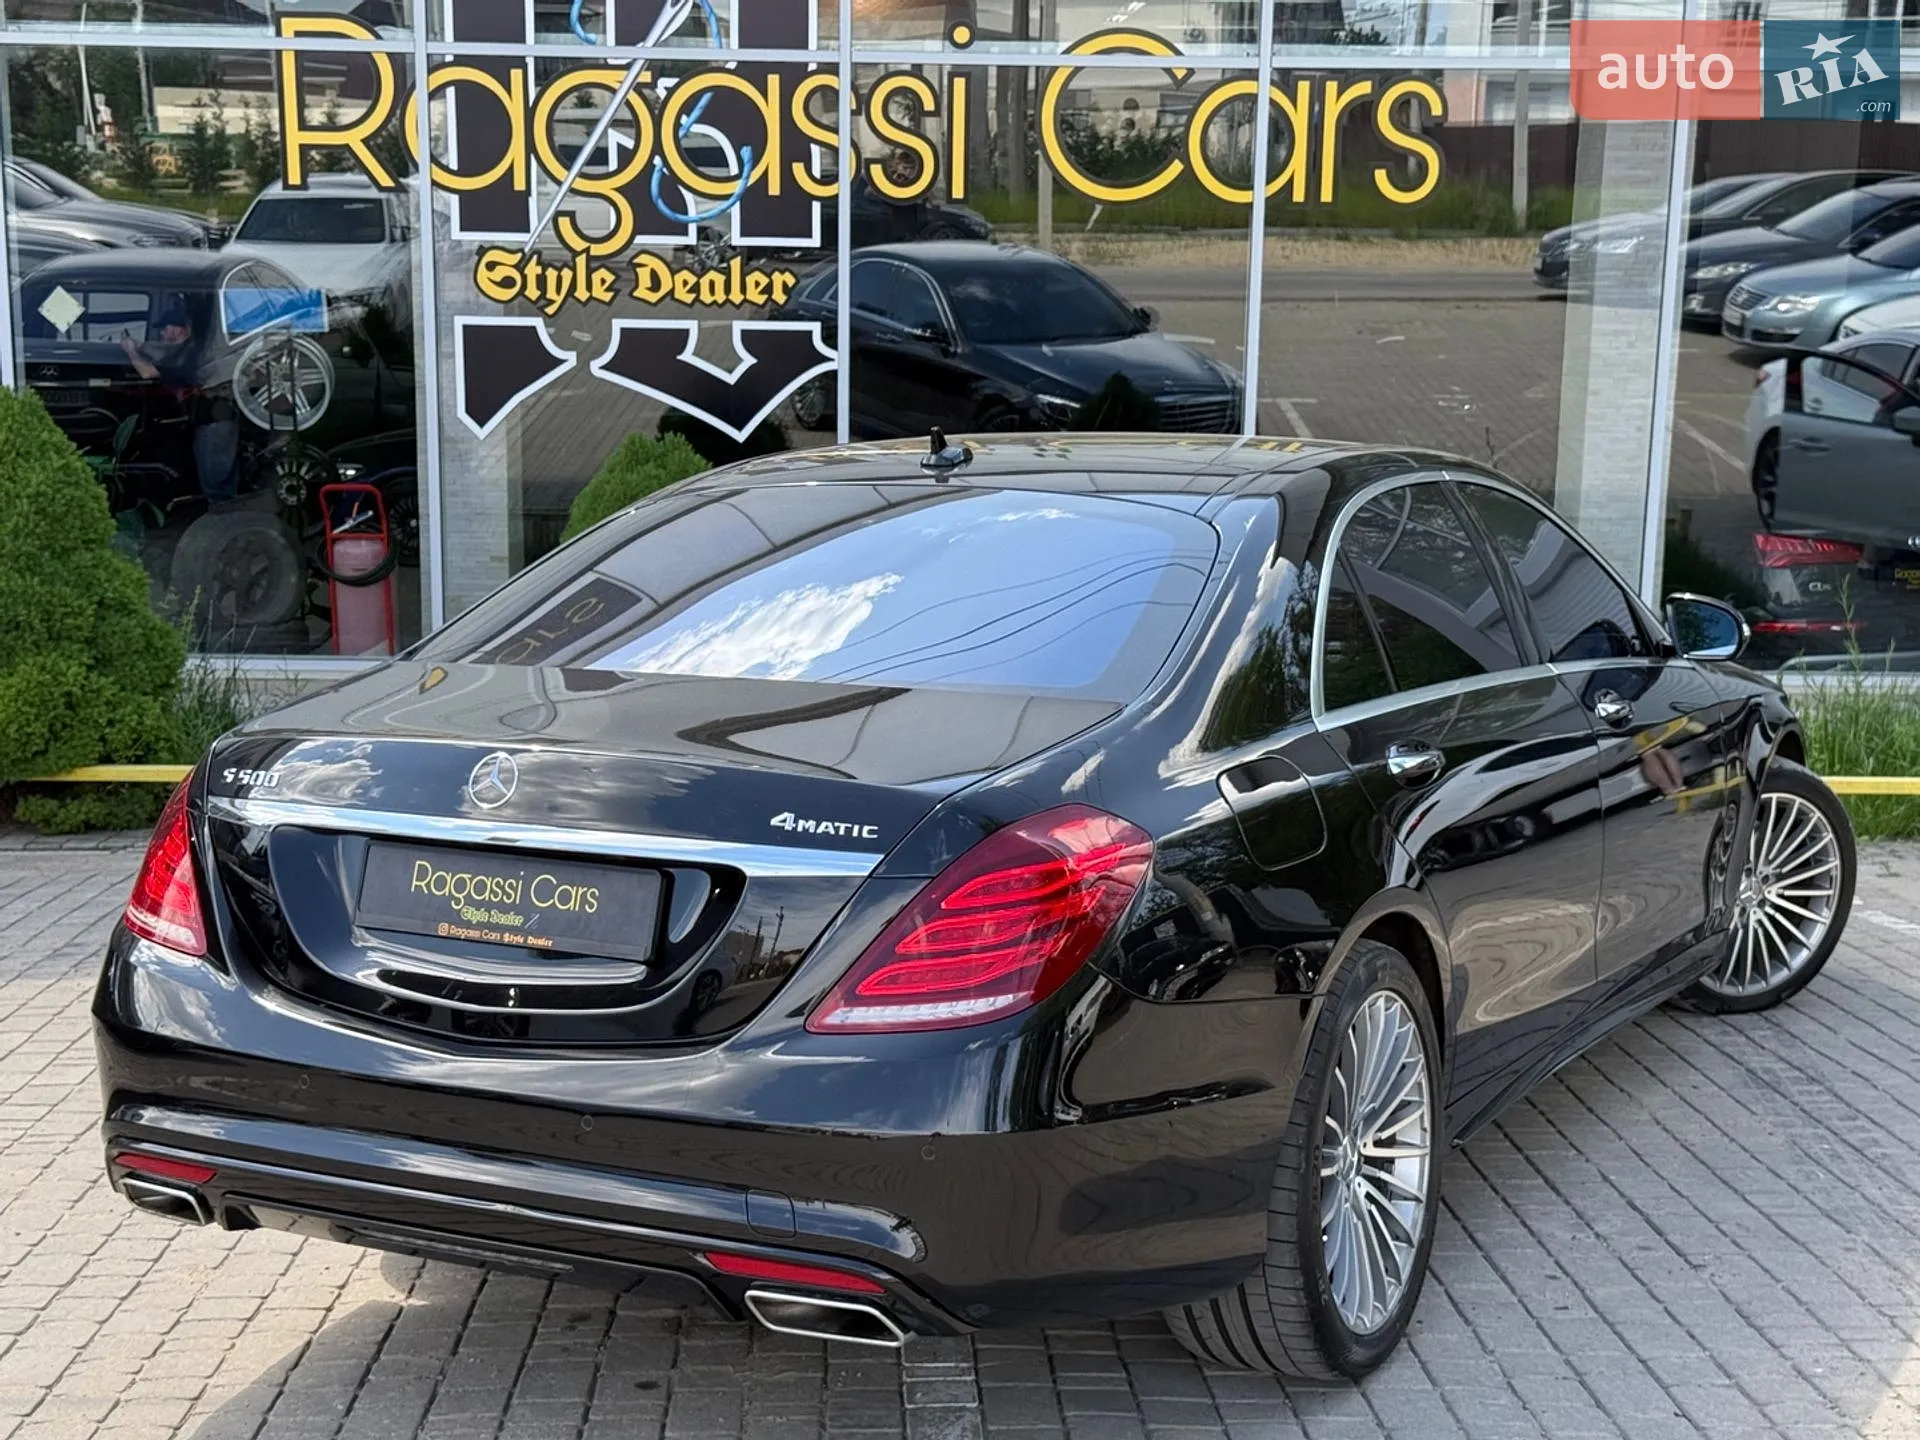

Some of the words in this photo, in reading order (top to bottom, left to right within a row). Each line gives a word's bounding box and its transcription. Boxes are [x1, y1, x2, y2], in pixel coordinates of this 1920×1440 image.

[276, 13, 970, 257] Ragassi
[1041, 28, 1448, 205] Cars
[475, 247, 617, 317] Style
[631, 252, 798, 306] Dealer
[222, 767, 237, 784] S
[238, 769, 280, 788] 500
[769, 811, 880, 839] 4MATIC
[410, 859, 525, 910] Ragassi
[530, 874, 600, 913] Cars
